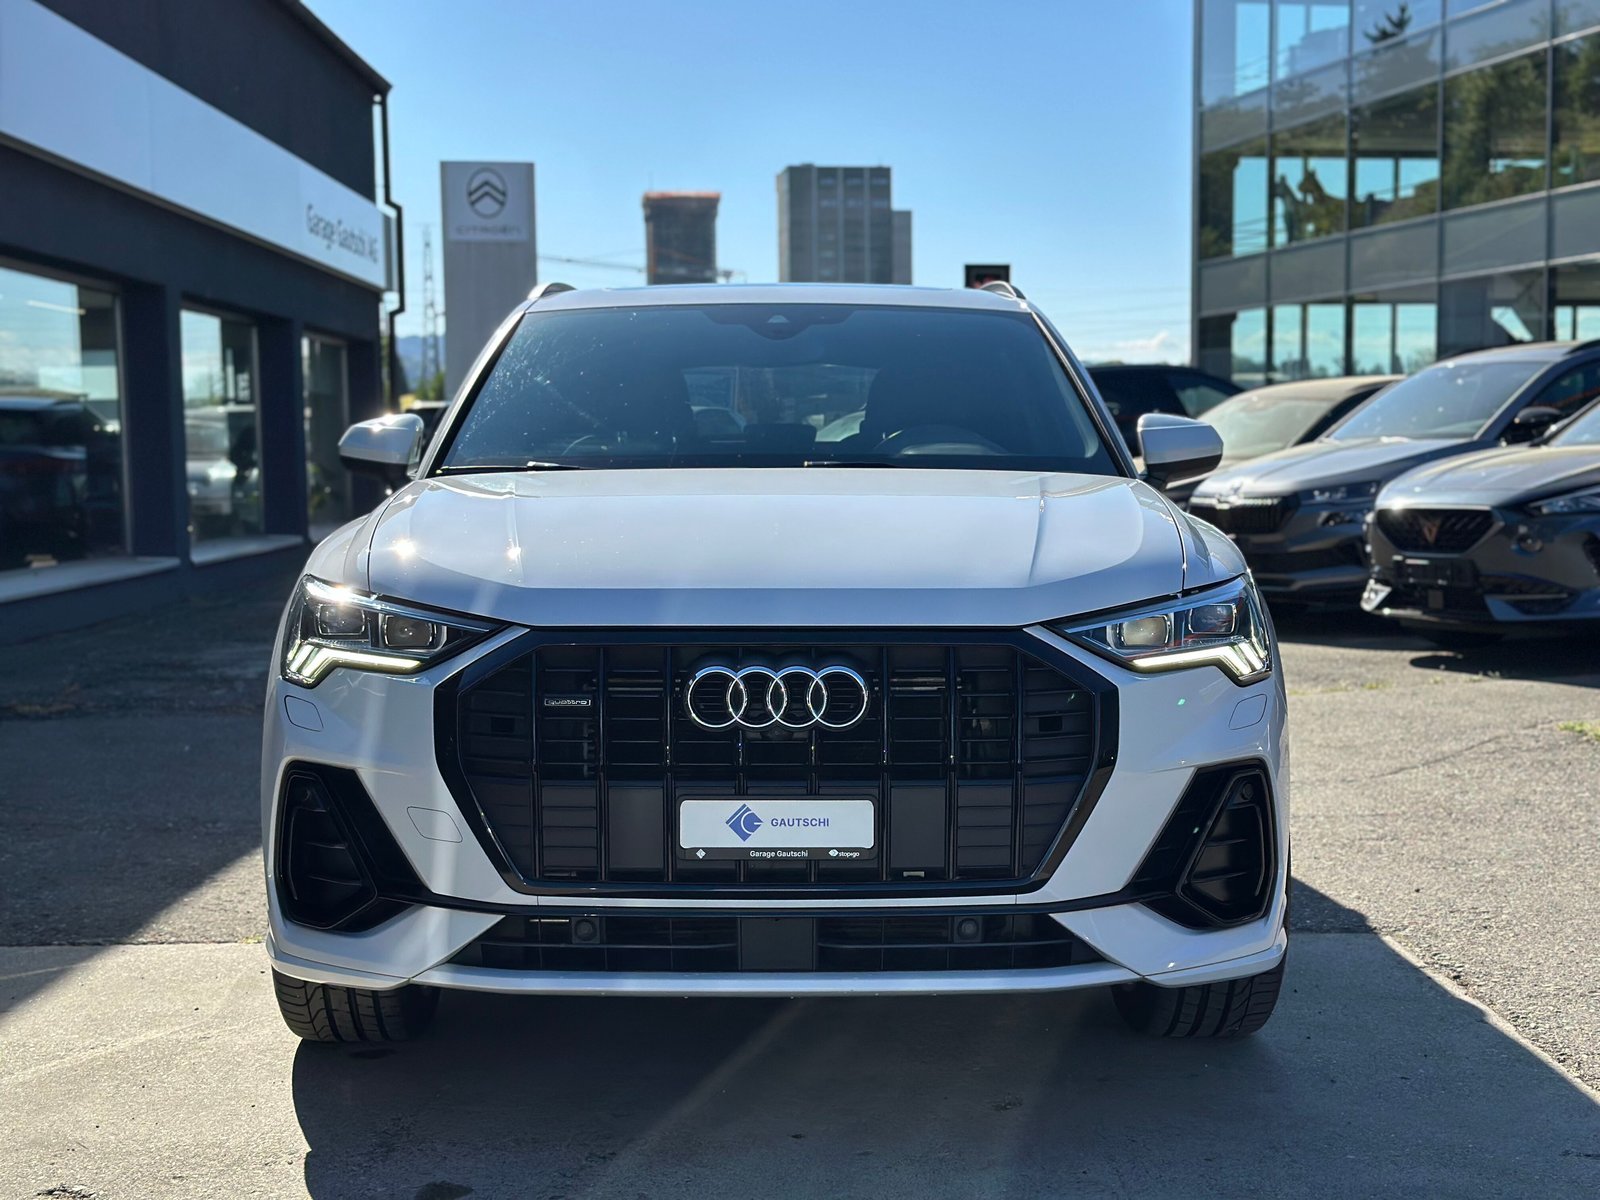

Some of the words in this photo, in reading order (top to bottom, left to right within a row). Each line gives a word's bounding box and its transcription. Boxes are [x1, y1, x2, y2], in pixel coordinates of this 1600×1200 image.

[770, 817, 830, 827] GAUTSCHI
[750, 850, 776, 859] Garage
[776, 849, 808, 857] Gautschi
